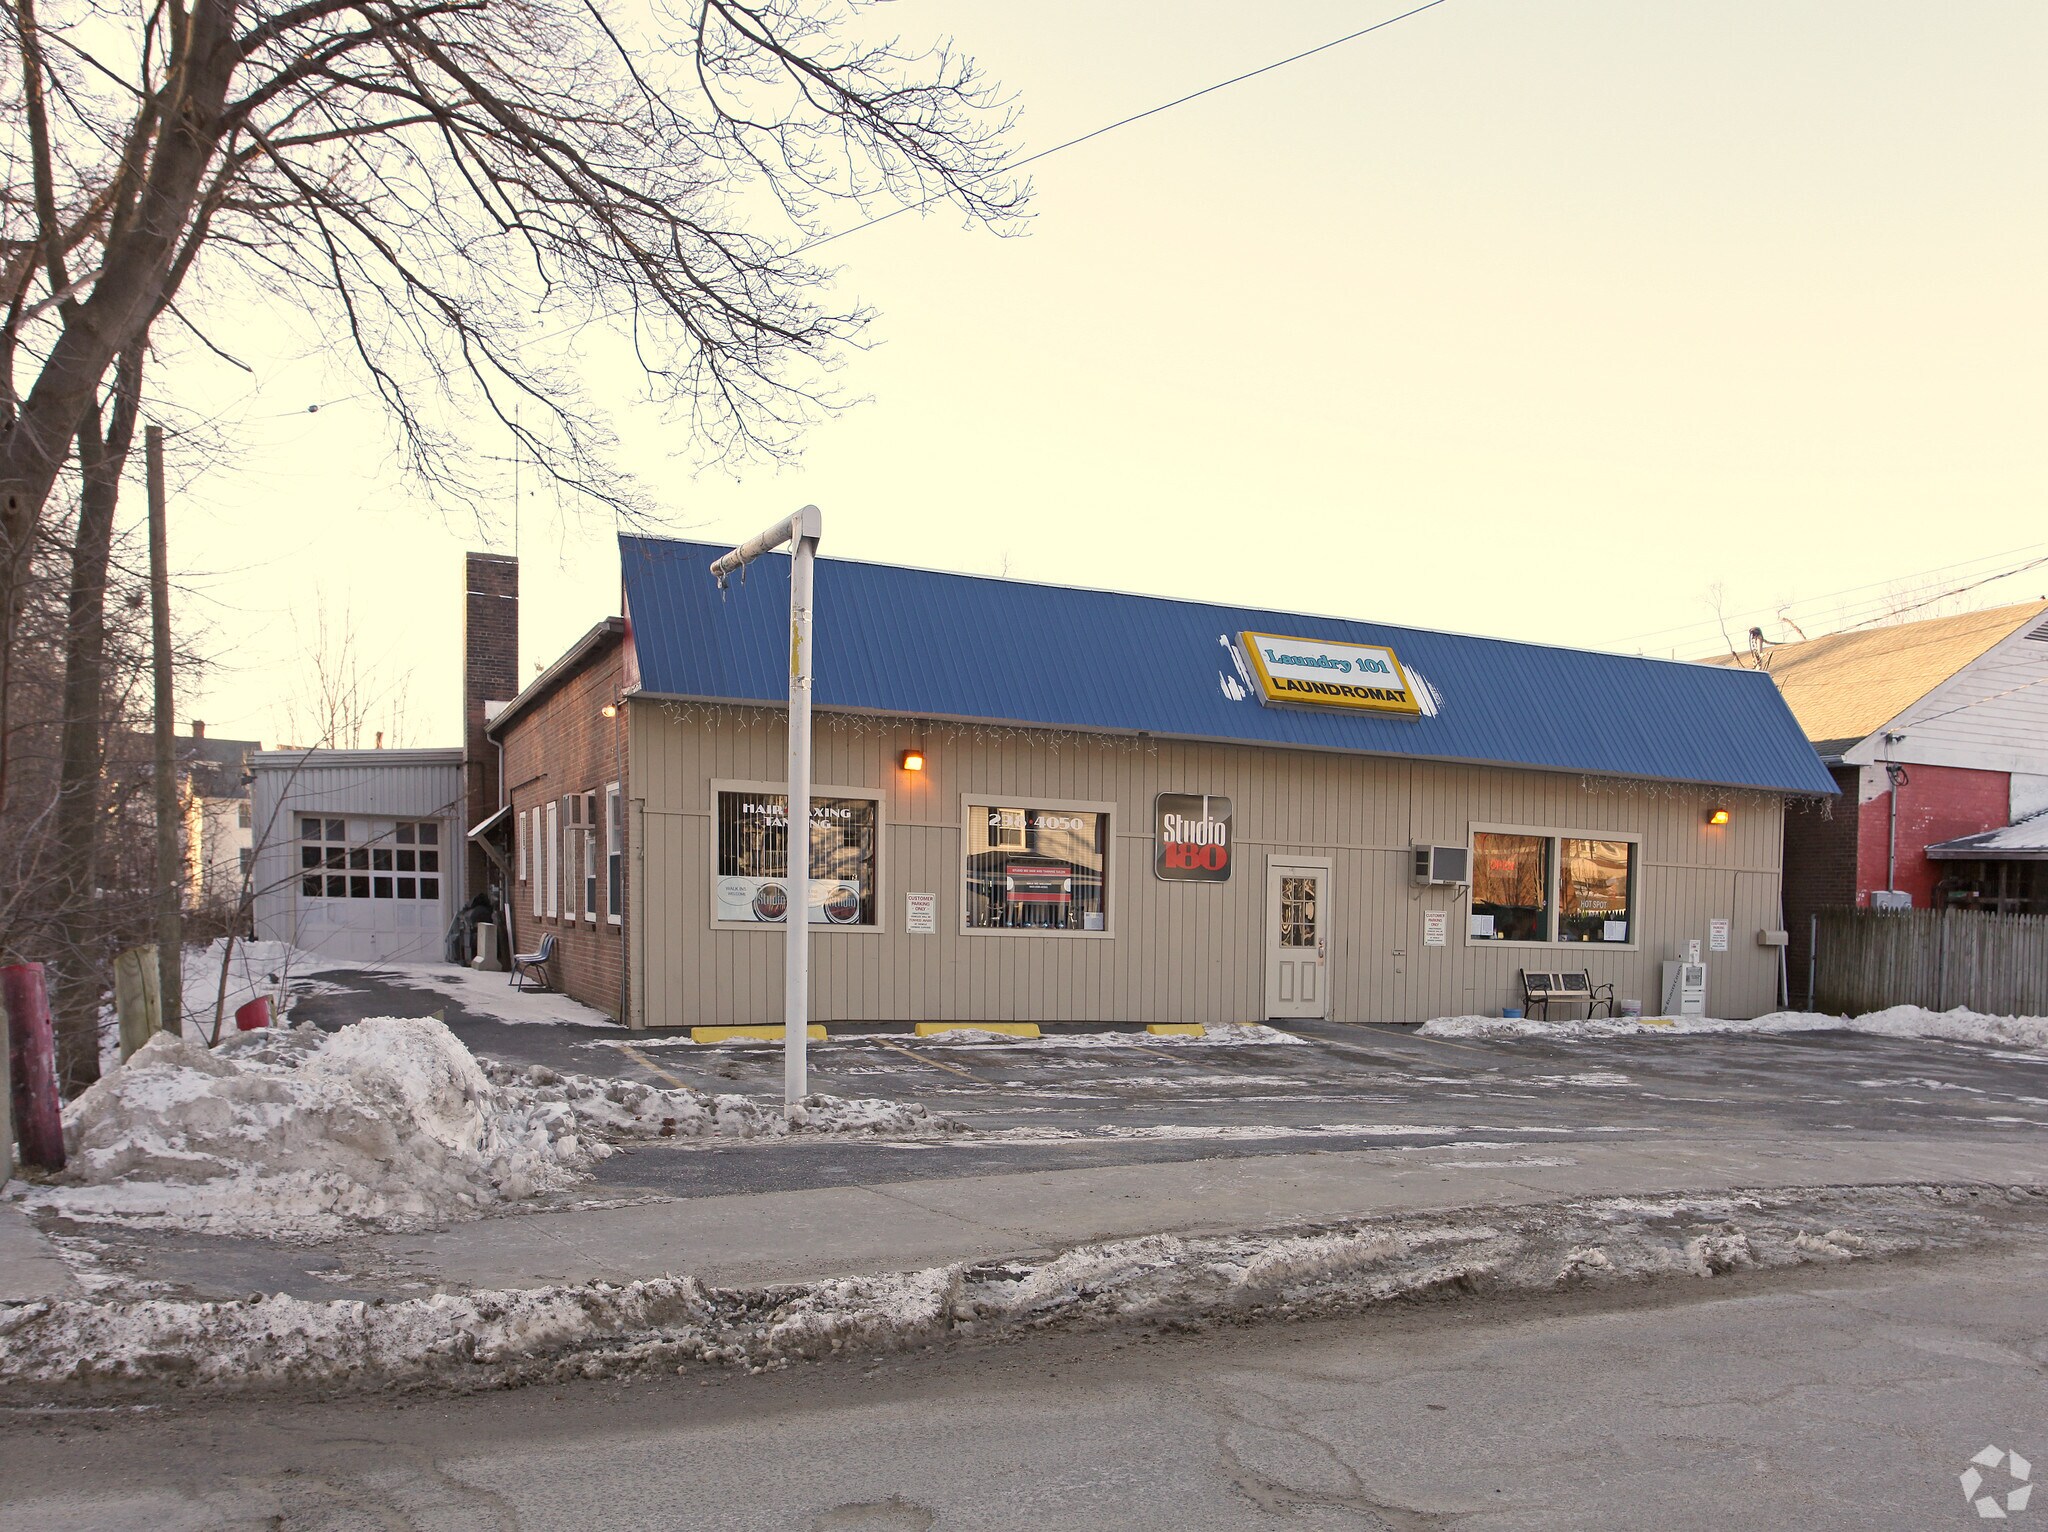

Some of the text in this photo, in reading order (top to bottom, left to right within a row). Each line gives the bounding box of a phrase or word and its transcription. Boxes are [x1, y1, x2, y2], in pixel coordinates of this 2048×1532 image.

[1265, 649, 1390, 674] Laundry 101
[1271, 677, 1406, 703] LAUNDROMAT
[743, 803, 783, 815] HAIR
[1163, 794, 1226, 847] Studio
[764, 816, 831, 829] TANNG
[1163, 841, 1228, 871] 180
[1580, 900, 1608, 909] HOT SPOT
